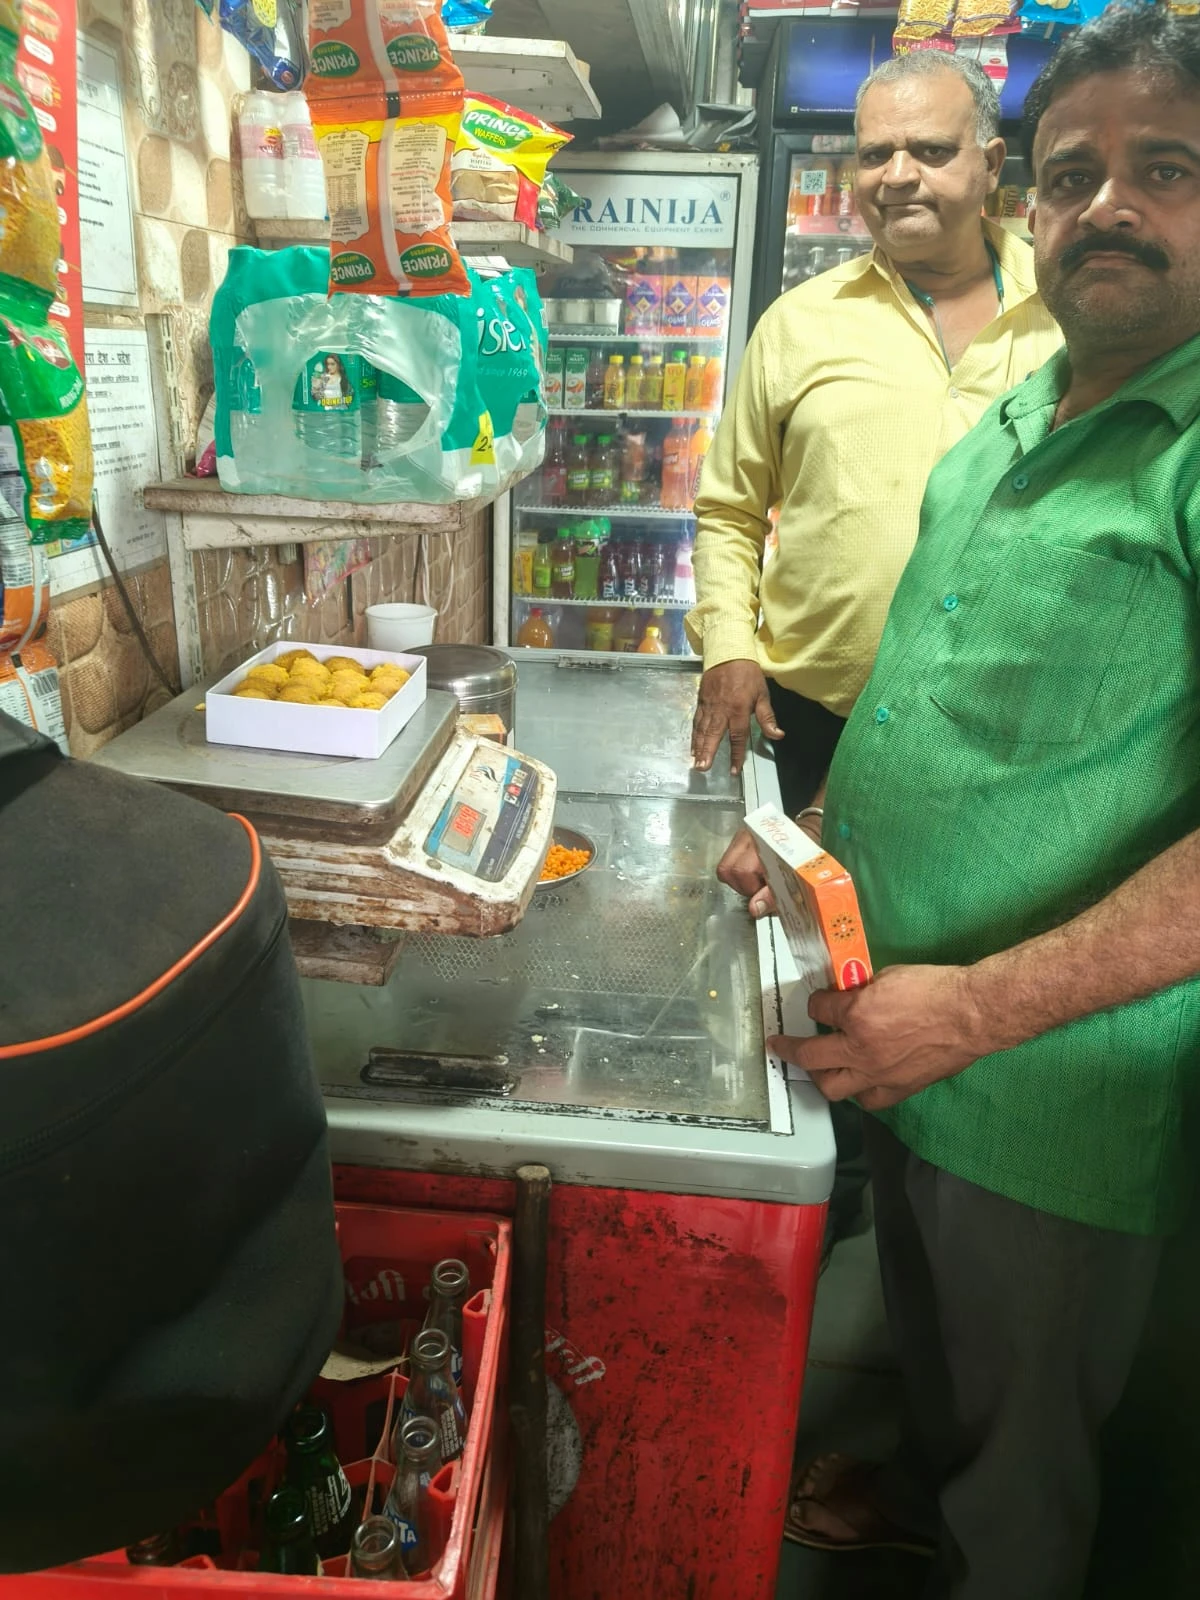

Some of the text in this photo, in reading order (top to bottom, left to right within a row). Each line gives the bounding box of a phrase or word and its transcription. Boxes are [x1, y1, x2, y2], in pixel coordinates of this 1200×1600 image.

[311, 52, 356, 74] PRINCE
[388, 46, 439, 65] PRINCE
[464, 111, 533, 141] PRINCE
[474, 127, 506, 147] WAFFERS
[573, 197, 723, 225] RAINIJA
[331, 262, 373, 281] PRINCE
[403, 252, 450, 273] PRINCE
[507, 367, 529, 377] 1969
